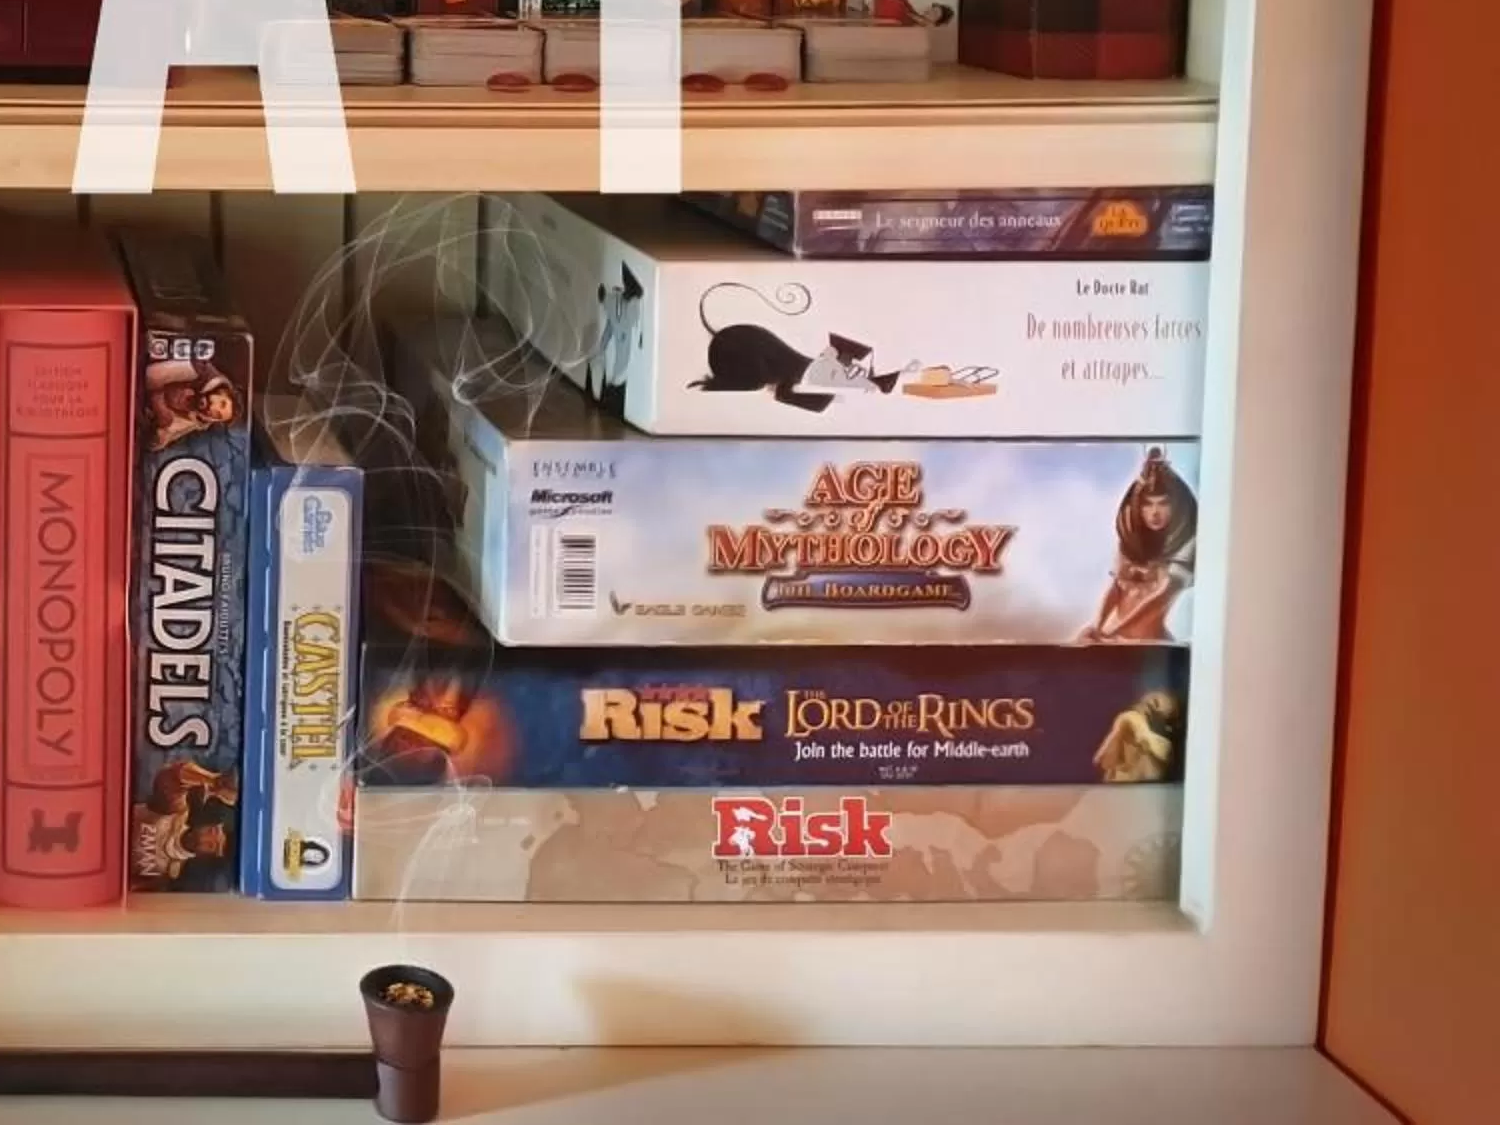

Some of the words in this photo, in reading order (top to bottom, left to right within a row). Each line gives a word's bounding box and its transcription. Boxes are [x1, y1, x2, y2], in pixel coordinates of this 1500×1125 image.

[875, 211, 895, 229] Le
[899, 212, 965, 232] seigneur
[968, 211, 995, 228] des
[998, 214, 1062, 229] anneaux
[1076, 278, 1091, 296] Le
[1093, 278, 1126, 296] Docte
[1129, 279, 1150, 296] Rat
[1026, 316, 1050, 341] De
[1054, 312, 1149, 341] nombreuses
[1153, 313, 1202, 340] farces
[1060, 359, 1075, 381] et
[531, 489, 614, 504] Microsoft
[804, 462, 921, 506] AGE
[850, 504, 881, 533] of
[706, 523, 1018, 573] MYTHOLOGY
[35, 470, 77, 758] MONOPOLY
[148, 457, 219, 750] CITADELS
[783, 689, 881, 740] LORD
[882, 714, 918, 730] THE
[888, 701, 915, 717] OF
[916, 693, 1035, 738] RINGS
[795, 741, 827, 761] Join
[831, 742, 854, 758] the
[858, 741, 902, 759] battle
[906, 741, 930, 759] for
[934, 741, 1030, 759] Middle-earth
